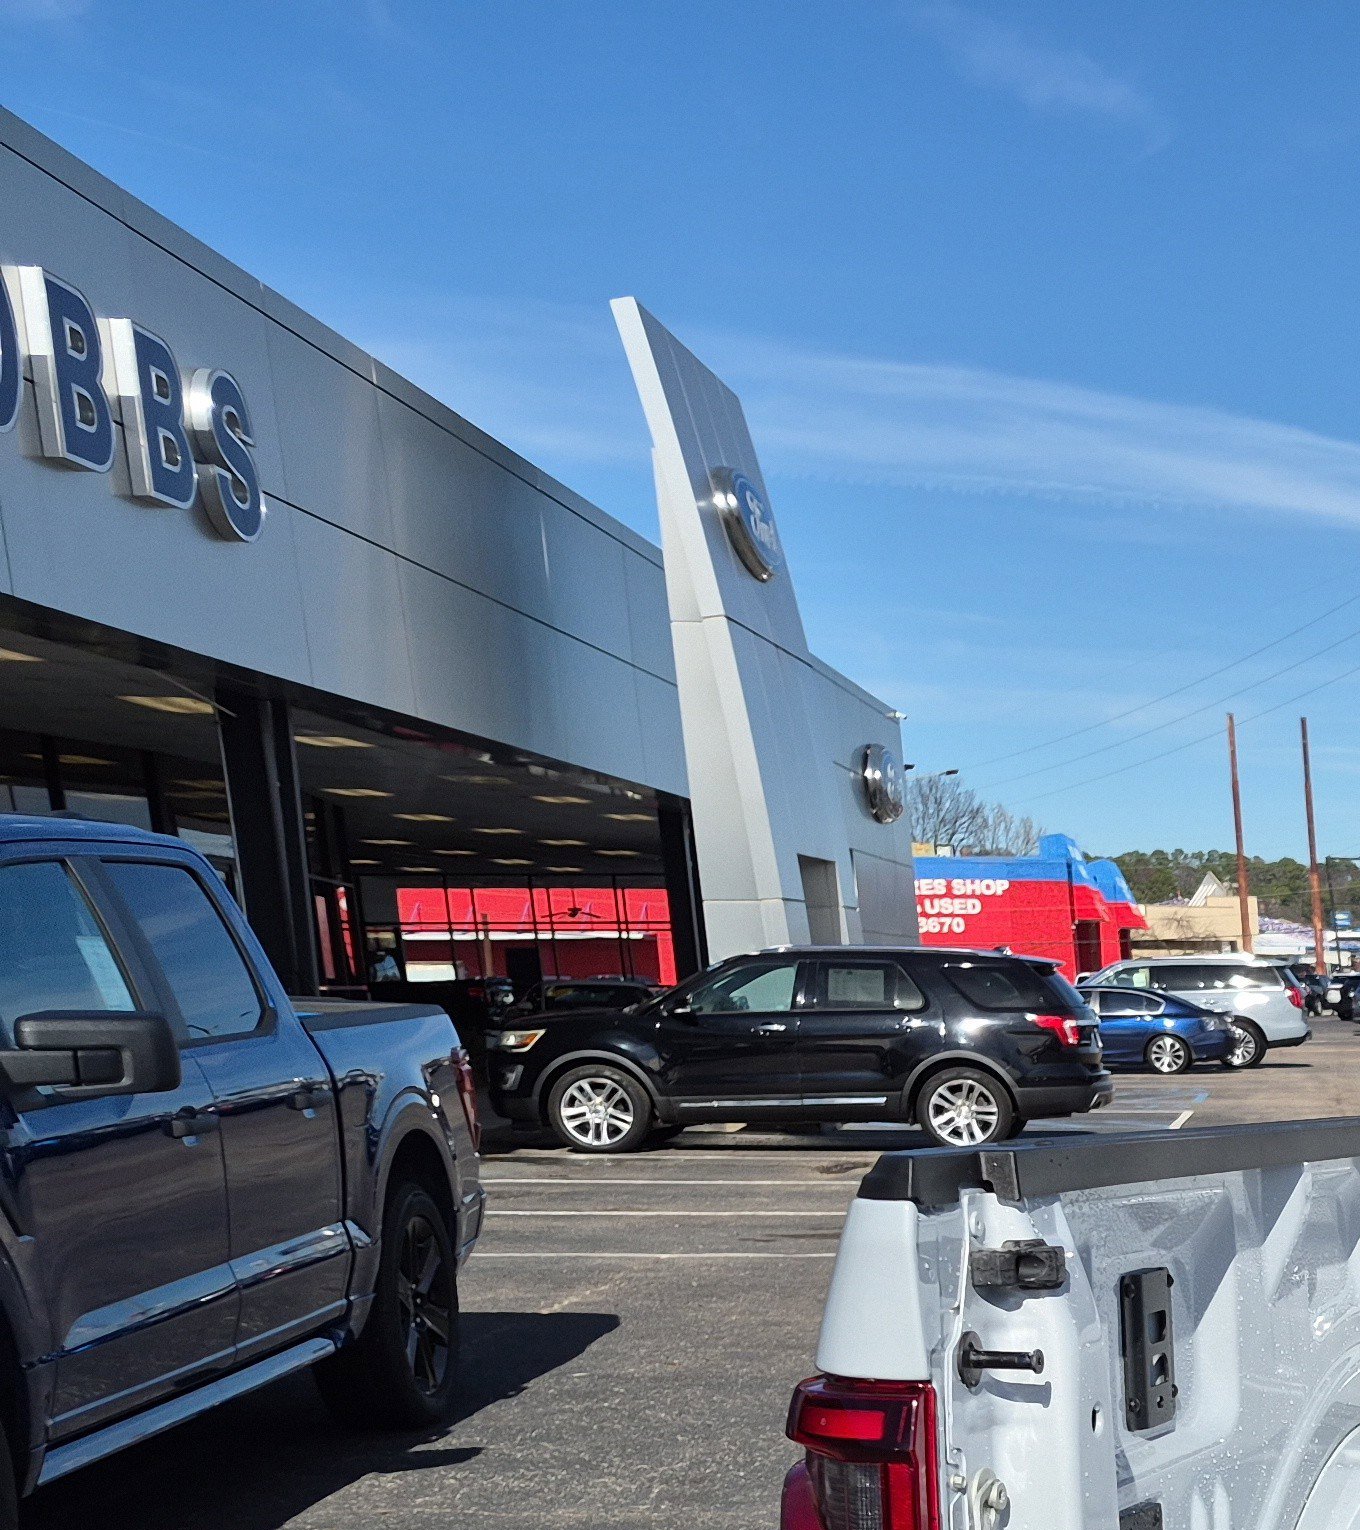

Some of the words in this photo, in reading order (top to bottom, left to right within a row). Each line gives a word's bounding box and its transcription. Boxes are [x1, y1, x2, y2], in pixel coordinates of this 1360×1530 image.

[0, 263, 266, 543] BBS
[951, 879, 1010, 896] SHOP
[923, 898, 982, 915] USED
